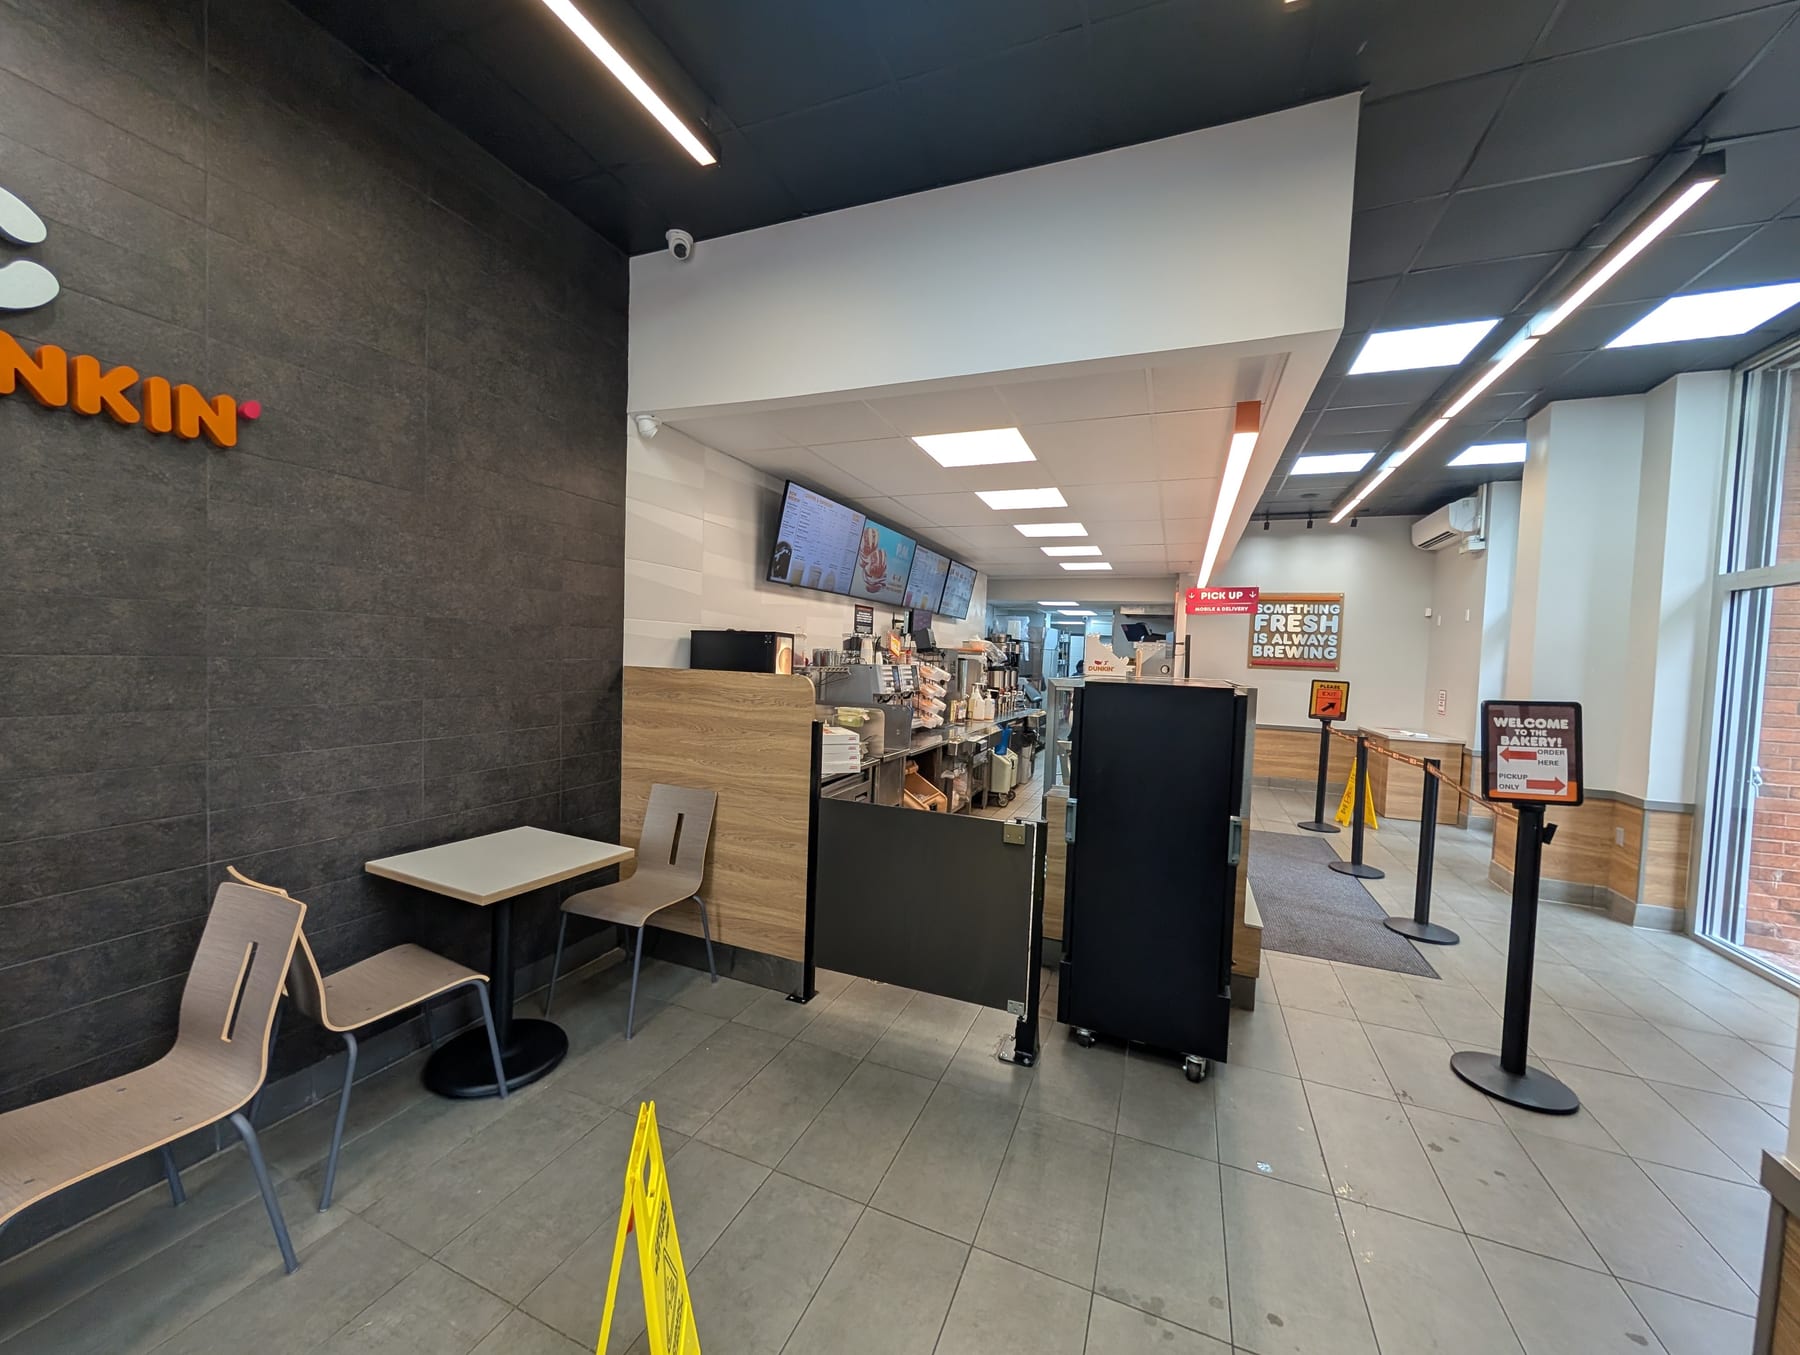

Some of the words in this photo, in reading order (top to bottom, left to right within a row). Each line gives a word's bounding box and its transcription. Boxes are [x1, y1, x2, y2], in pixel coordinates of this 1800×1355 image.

[1200, 591, 1226, 600] PICK
[1228, 591, 1243, 600] UP
[1256, 603, 1341, 615] SOMETHING
[1254, 614, 1340, 634] FRESH
[1253, 632, 1267, 644] IS
[1271, 633, 1338, 646] ALWAYS
[1252, 645, 1338, 660] BREWING
[1493, 717, 1569, 730] WELCOME
[1529, 729, 1548, 737] THE
[1500, 735, 1563, 747] BAKERY!
